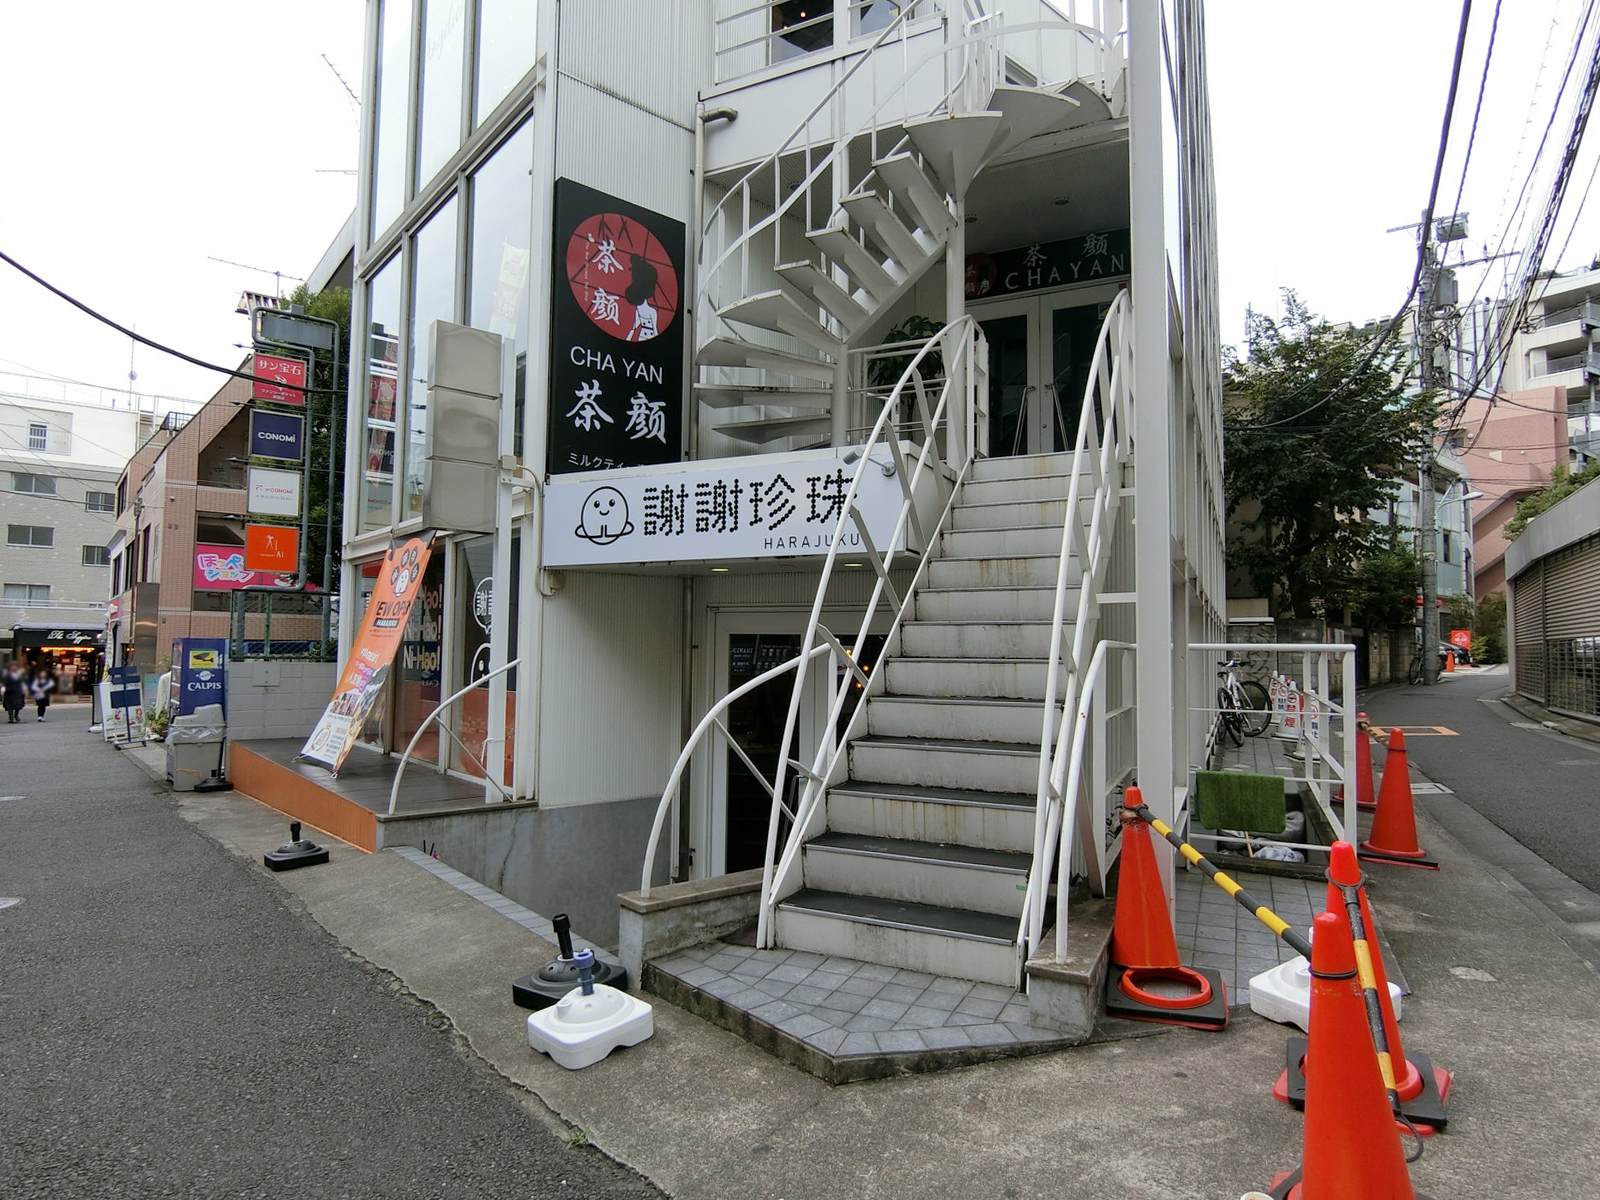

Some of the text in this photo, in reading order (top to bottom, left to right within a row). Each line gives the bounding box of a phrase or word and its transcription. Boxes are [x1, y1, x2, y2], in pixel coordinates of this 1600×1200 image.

[258, 360, 302, 375] サン宝石
[570, 346, 663, 385] CHA YAN
[643, 468, 858, 536] 謝謝珍珠
[764, 533, 860, 549] HARAJUKU
[403, 646, 440, 671] Ni-Hao!
[187, 682, 222, 692] CALPIS
